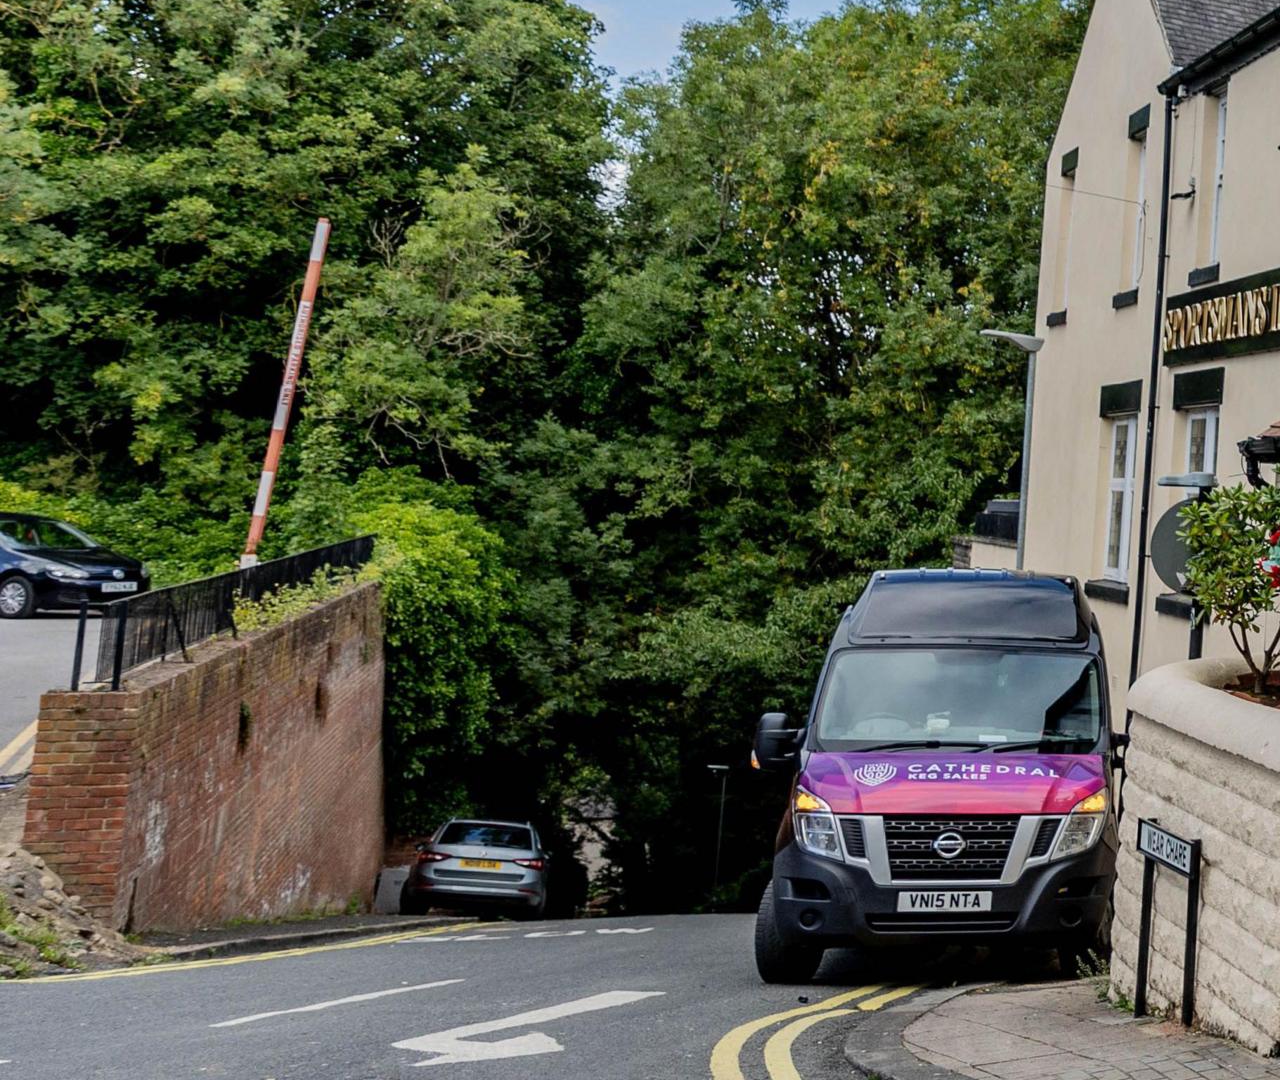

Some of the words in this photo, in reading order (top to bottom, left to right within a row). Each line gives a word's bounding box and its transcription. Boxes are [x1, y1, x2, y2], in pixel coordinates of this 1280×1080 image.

[1163, 285, 1271, 353] SPORTSMANS
[907, 763, 1060, 778] CATHEDRAL
[907, 772, 938, 780] KEG
[943, 773, 988, 781] SALES
[1147, 826, 1164, 857] WEAR
[1165, 837, 1187, 868] CHARE
[910, 893, 946, 908] VN15
[949, 893, 981, 908] NTA
